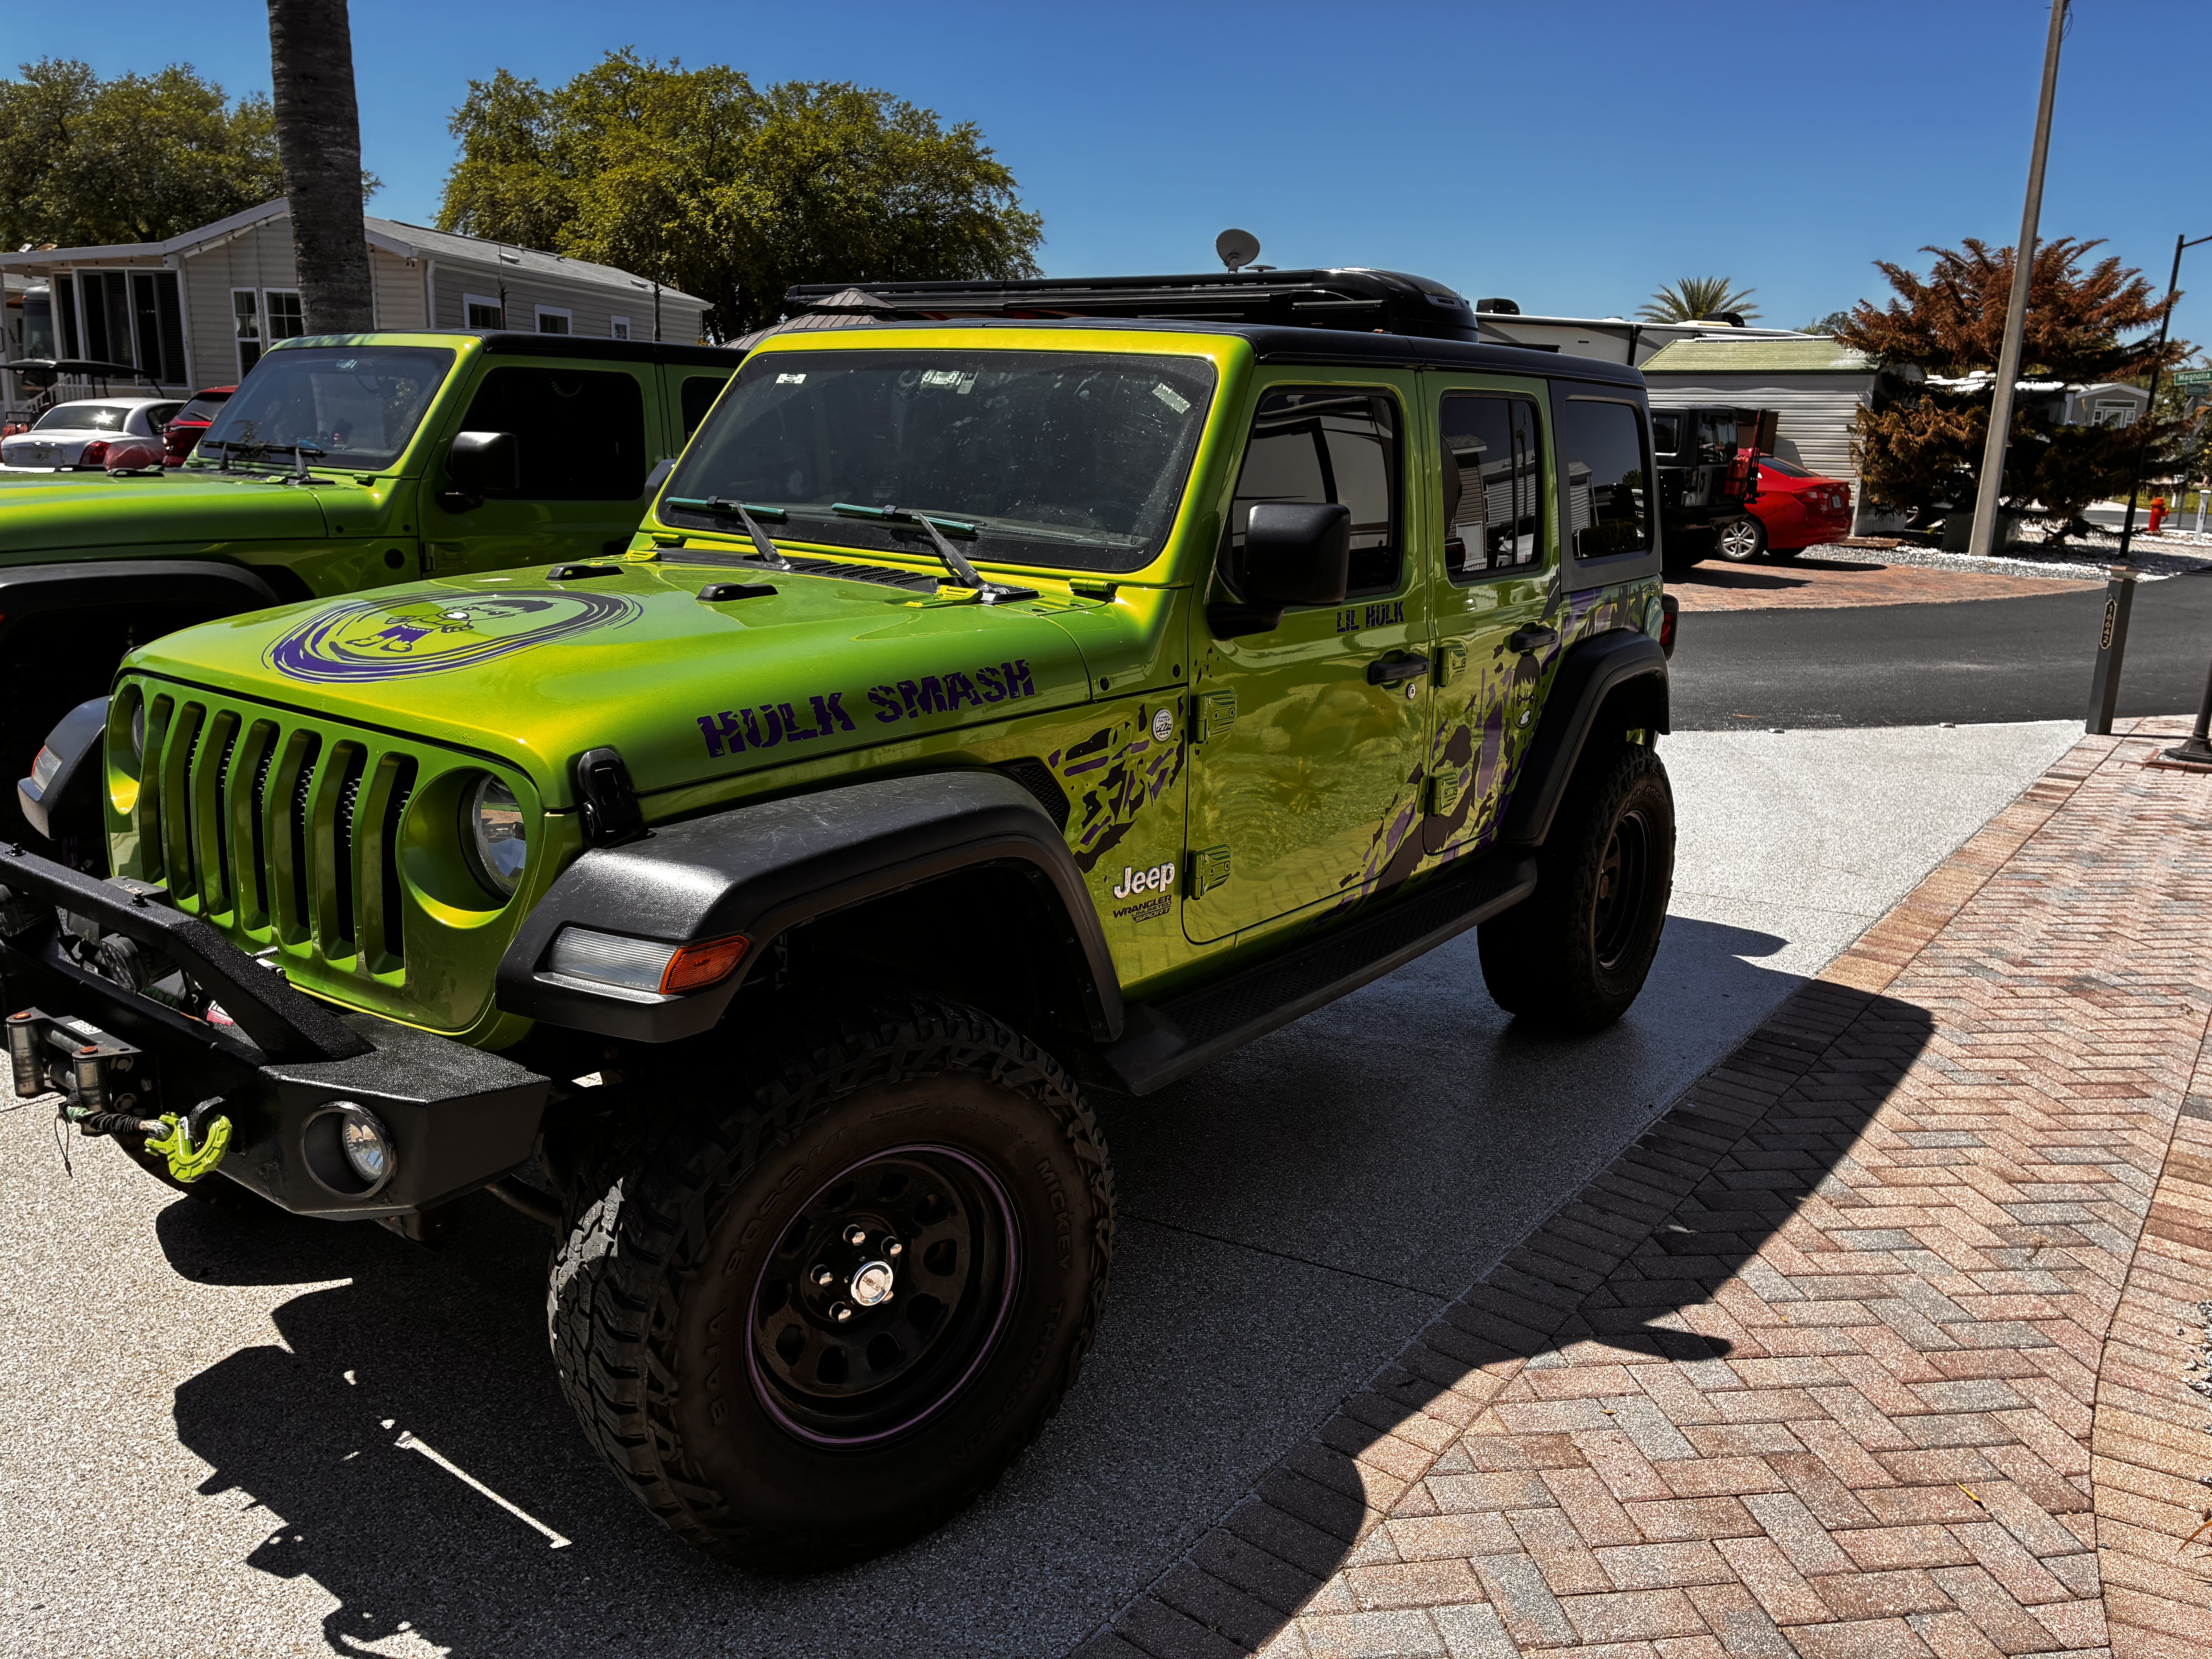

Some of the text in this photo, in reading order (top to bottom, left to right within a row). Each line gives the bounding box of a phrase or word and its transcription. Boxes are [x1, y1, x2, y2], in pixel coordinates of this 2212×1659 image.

[2178, 372, 2210, 383] Magnolia
[1337, 601, 1404, 633] LIL HULK
[2103, 605, 2113, 643] 16642
[697, 659, 1036, 758] HULK SMASH
[1113, 861, 1175, 899] Jeep
[1112, 895, 1172, 919] WRANGLER
[1132, 901, 1172, 917] UNLIMITED
[1135, 907, 1170, 921] SPORT
[951, 1105, 977, 1115] MADE
[994, 1118, 1008, 1128] THE
[703, 1307, 728, 1427] BAJA
[722, 1164, 805, 1277] BOSS
[945, 1156, 1072, 1468] MICKEY THOMPSON
